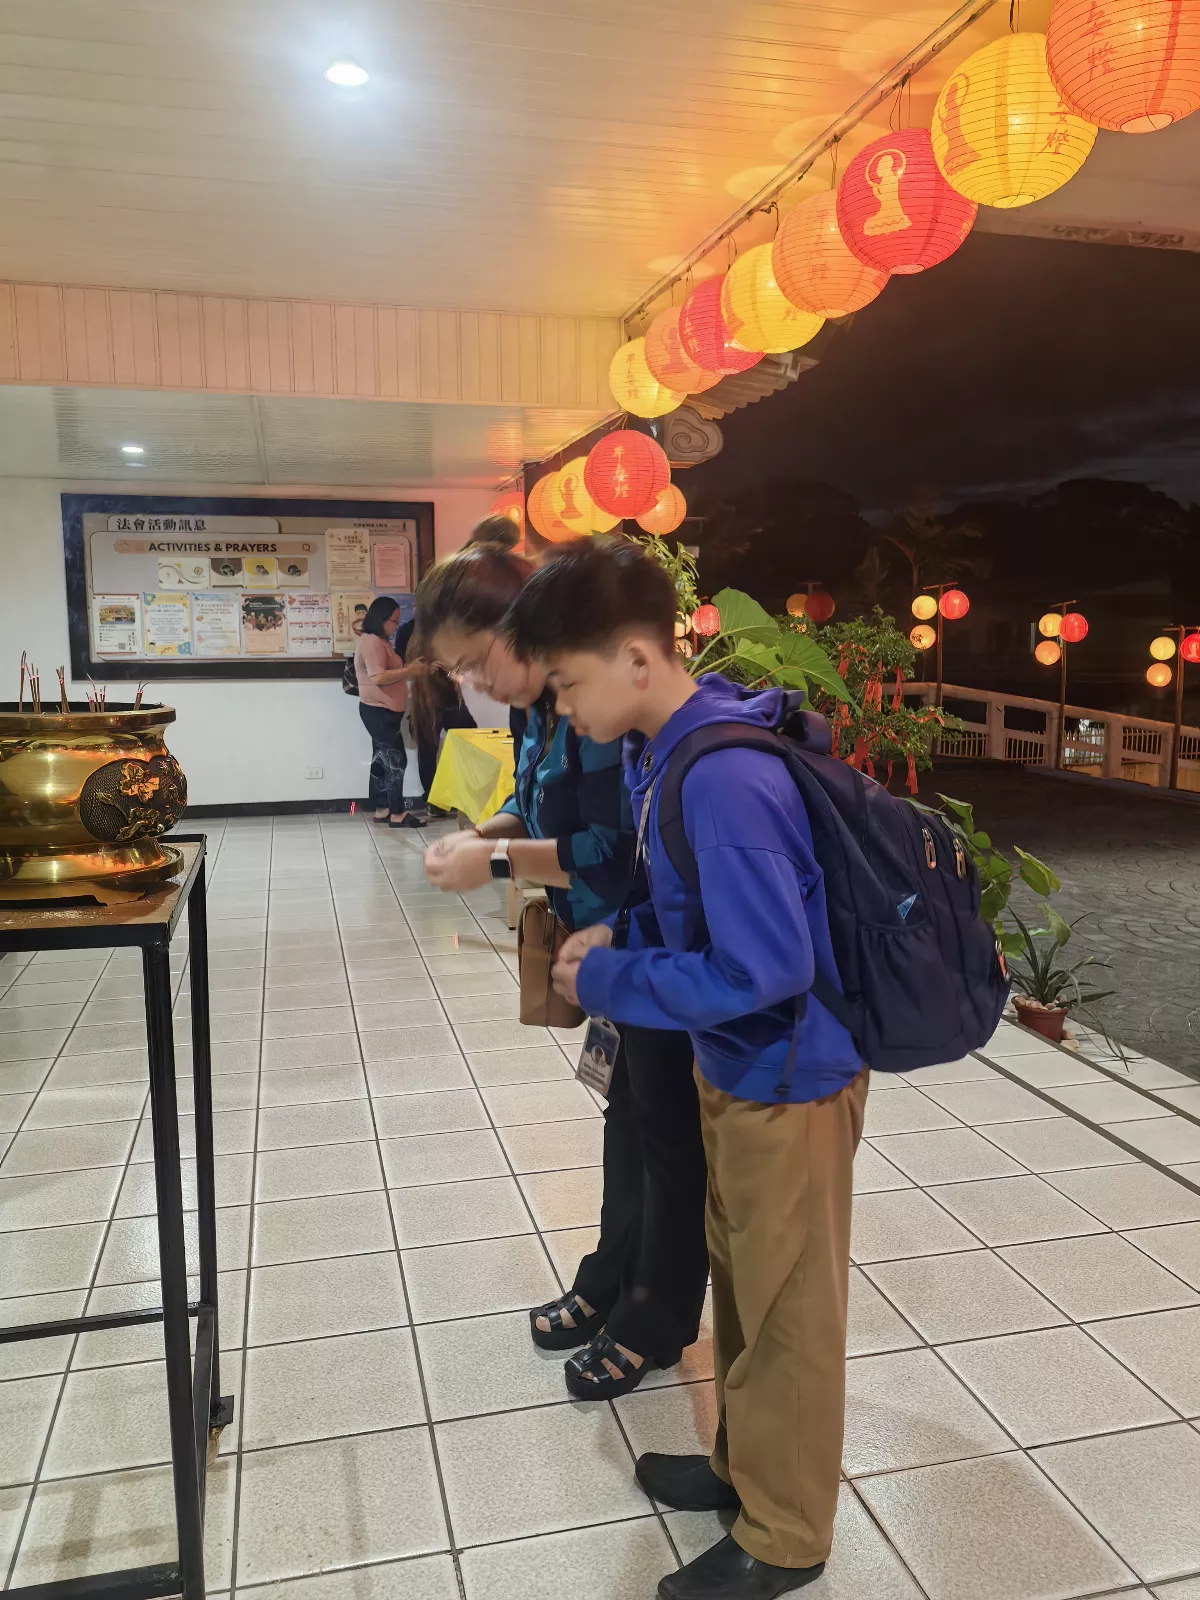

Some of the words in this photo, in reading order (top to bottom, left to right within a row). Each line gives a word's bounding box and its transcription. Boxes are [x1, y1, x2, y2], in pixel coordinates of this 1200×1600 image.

[116, 518, 207, 532] 法會活動訊息
[148, 543, 211, 552] ACTIVITIES
[213, 543, 223, 552] &
[225, 543, 277, 553] PRAYERS
